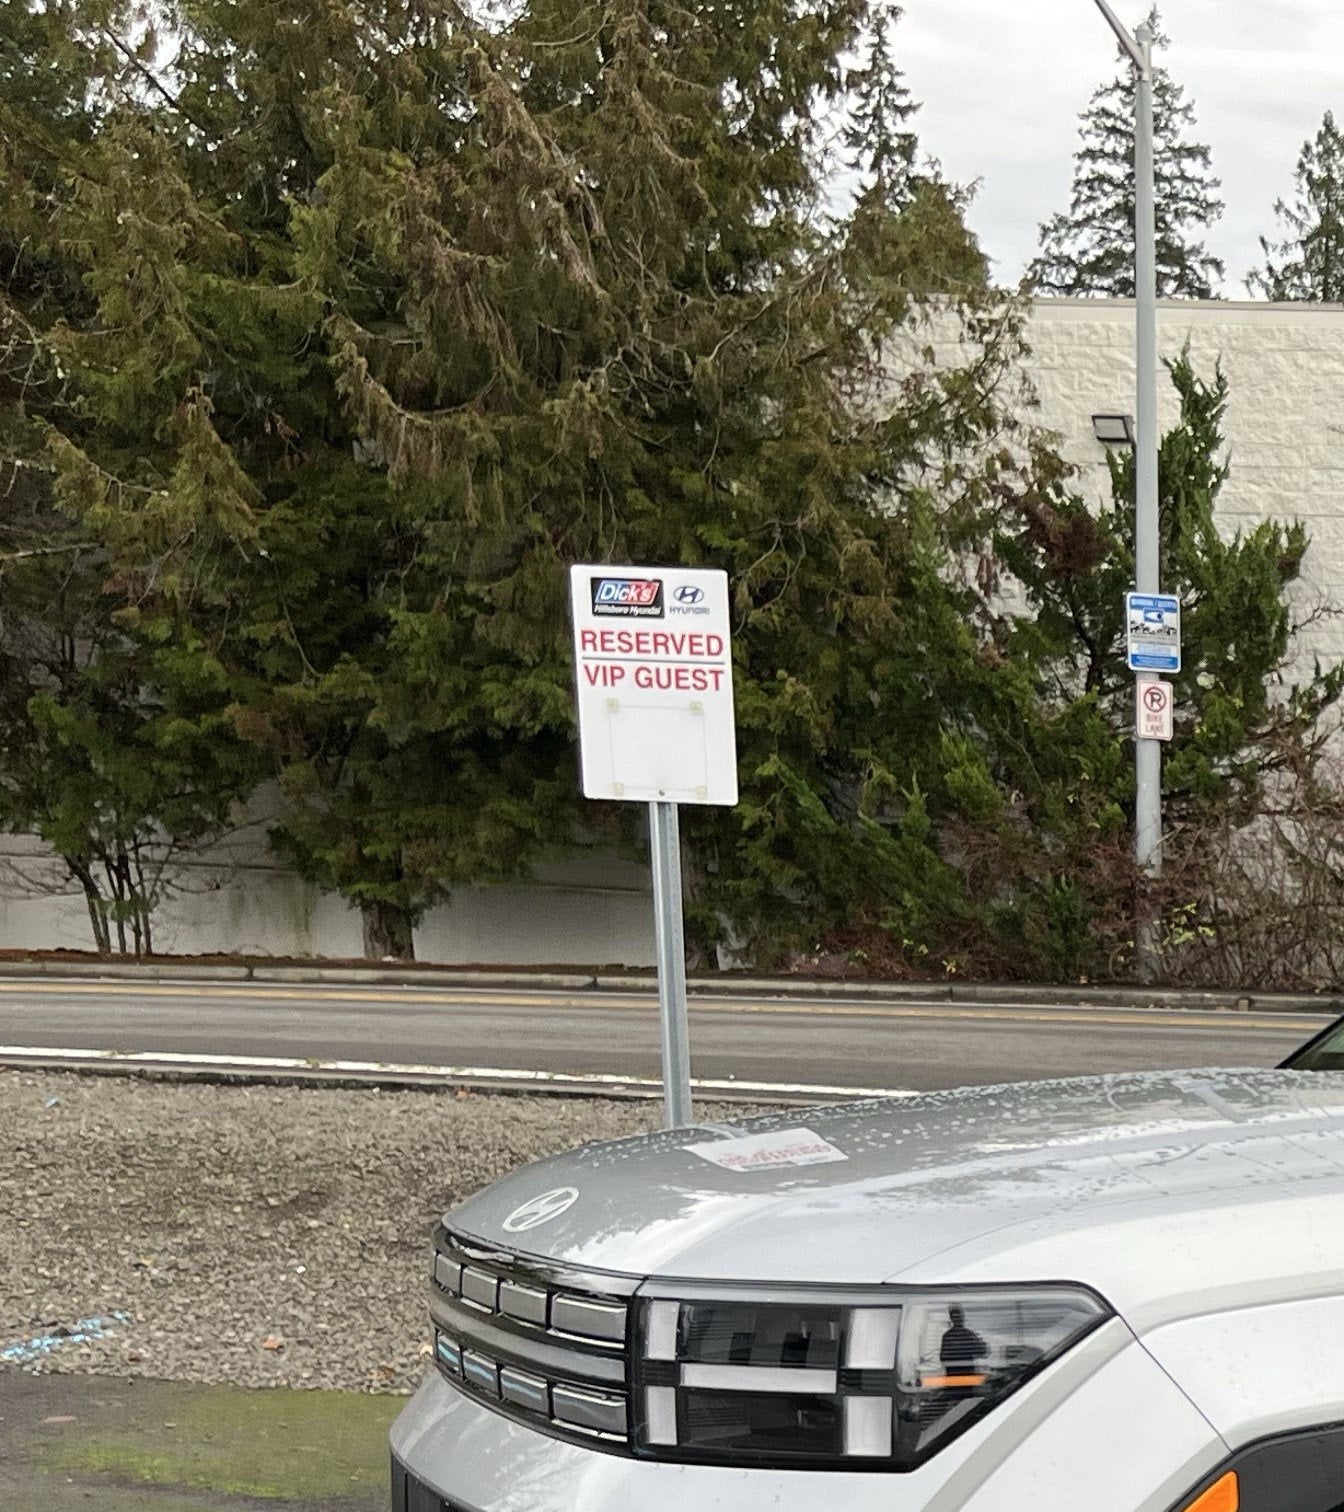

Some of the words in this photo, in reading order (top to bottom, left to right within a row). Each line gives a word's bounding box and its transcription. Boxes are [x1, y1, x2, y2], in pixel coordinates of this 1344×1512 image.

[581, 630, 723, 657] RESERVED
[584, 664, 625, 688] VIP
[634, 666, 724, 691] GUEST
